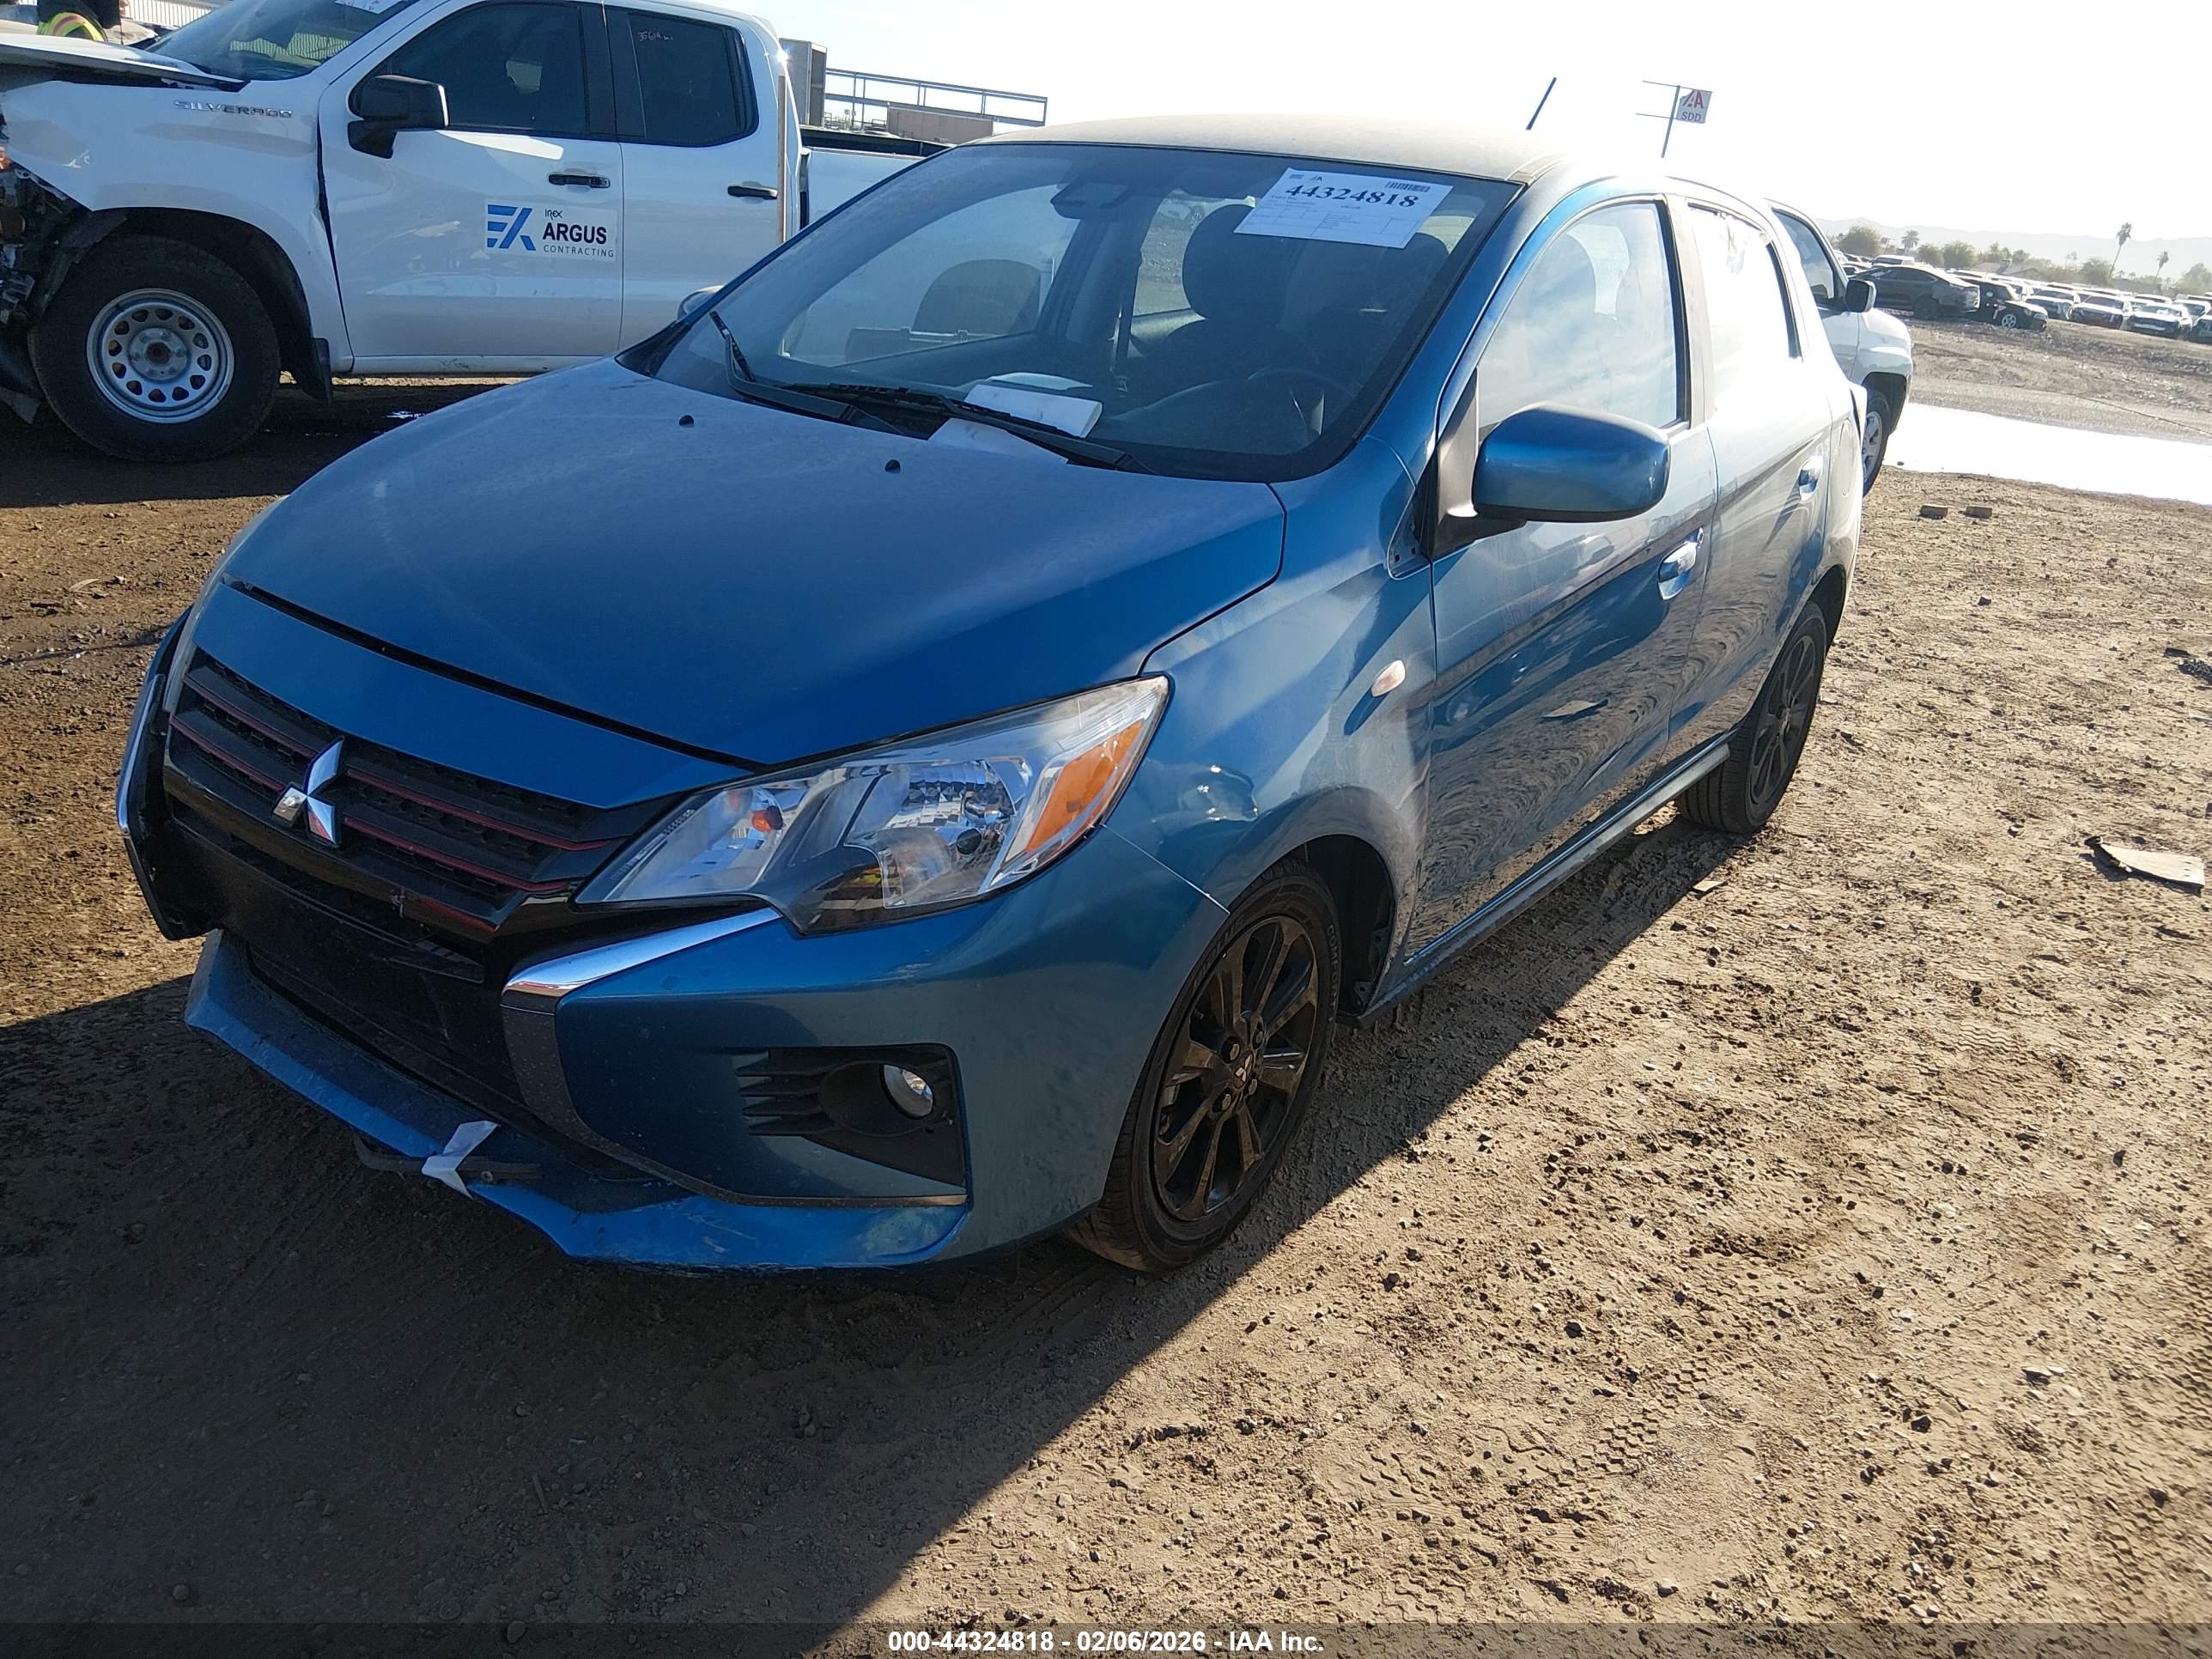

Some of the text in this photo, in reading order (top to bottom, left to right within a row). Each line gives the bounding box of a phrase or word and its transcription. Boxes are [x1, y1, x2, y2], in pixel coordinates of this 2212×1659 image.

[174, 100, 294, 118] SILVERADO
[1680, 111, 1702, 122] SDD
[1285, 185, 1419, 207] 44324818
[542, 222, 607, 245] ARGUS
[543, 244, 615, 258] CONTRACTING
